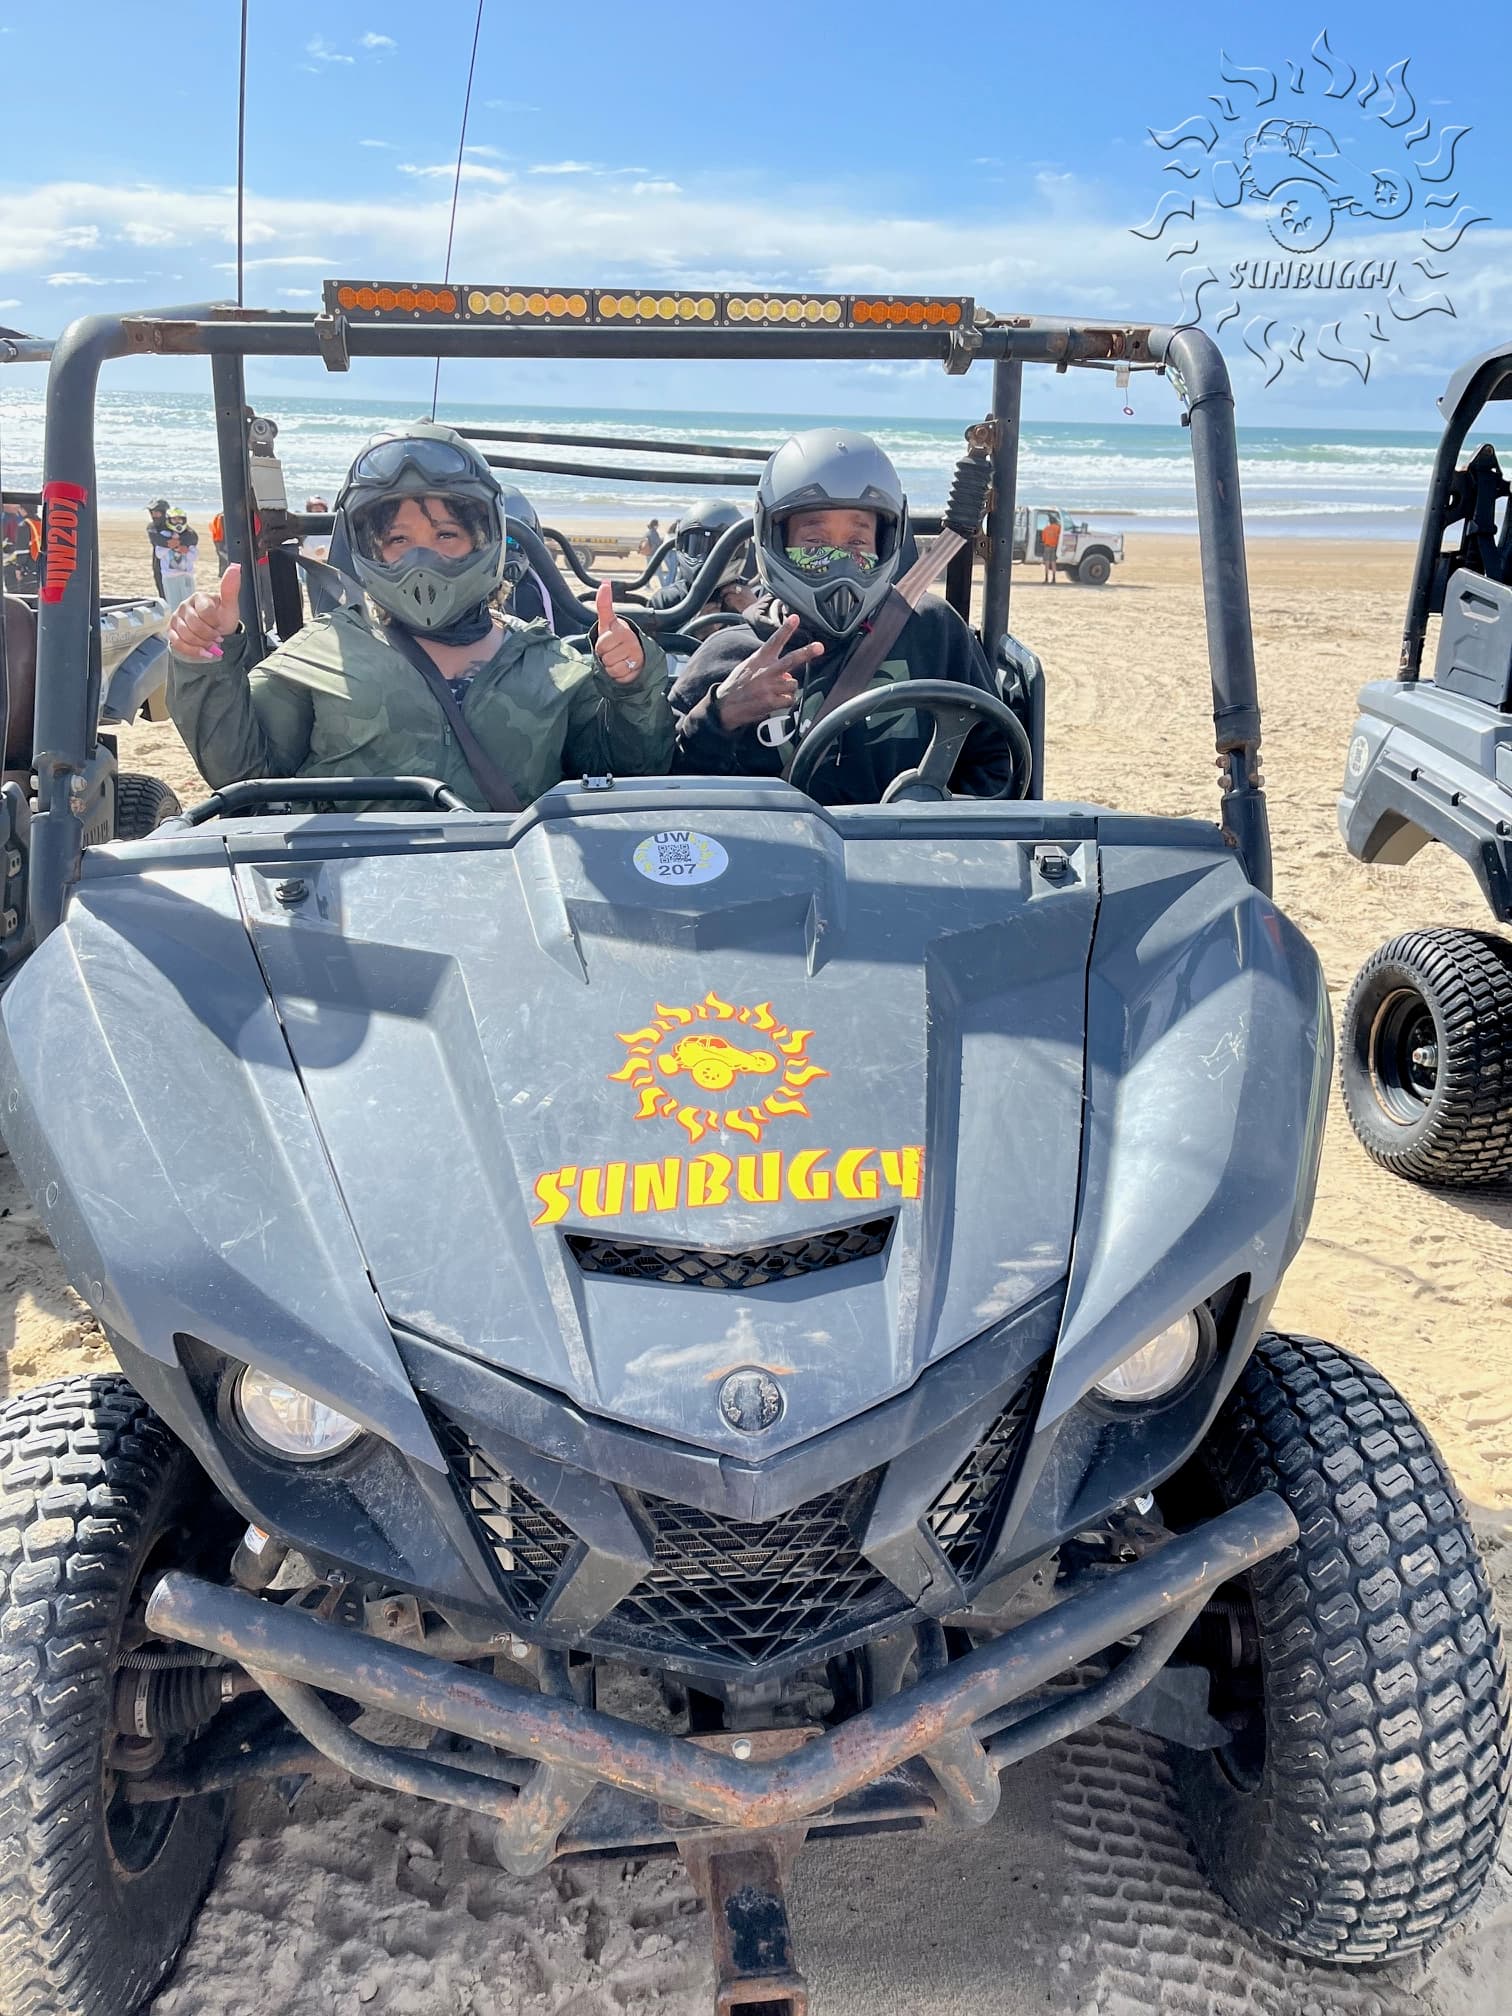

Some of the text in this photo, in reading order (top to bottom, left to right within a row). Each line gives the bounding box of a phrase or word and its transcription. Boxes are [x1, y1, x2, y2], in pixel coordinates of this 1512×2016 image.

[46, 497, 79, 588] UW207
[654, 832, 690, 844] UW
[658, 863, 697, 876] 207
[531, 1145, 926, 1227] SUNBUGGY
